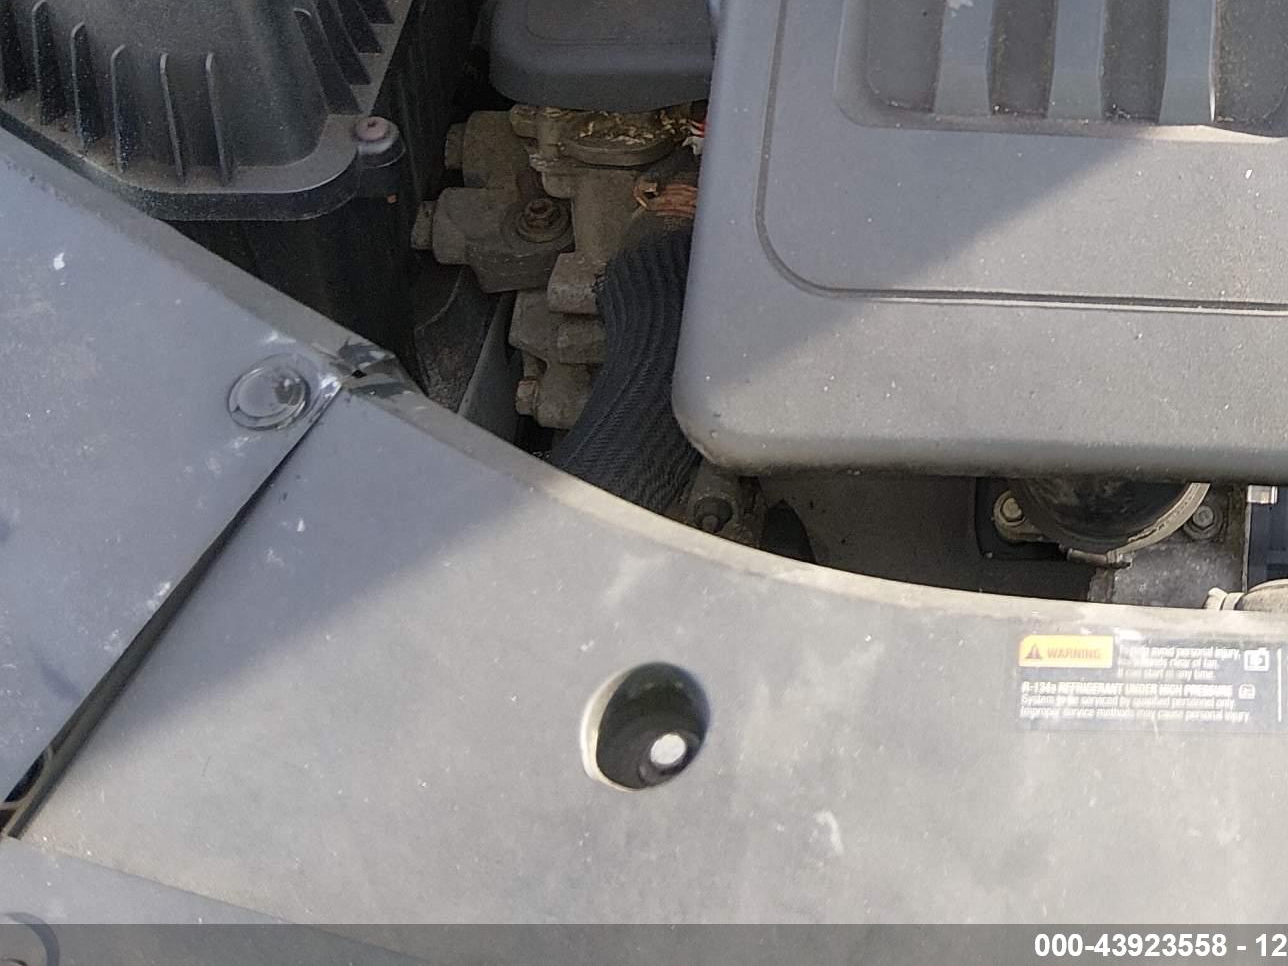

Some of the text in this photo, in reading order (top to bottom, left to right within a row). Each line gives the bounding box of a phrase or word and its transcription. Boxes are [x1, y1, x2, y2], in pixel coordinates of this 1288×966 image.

[1047, 648, 1102, 659] WARNING
[1176, 647, 1213, 660] personal
[1021, 681, 1056, 694] R-134a
[1058, 681, 1124, 695] REFRIGERANT
[1020, 706, 1060, 720] Improper
[1063, 707, 1095, 719] service
